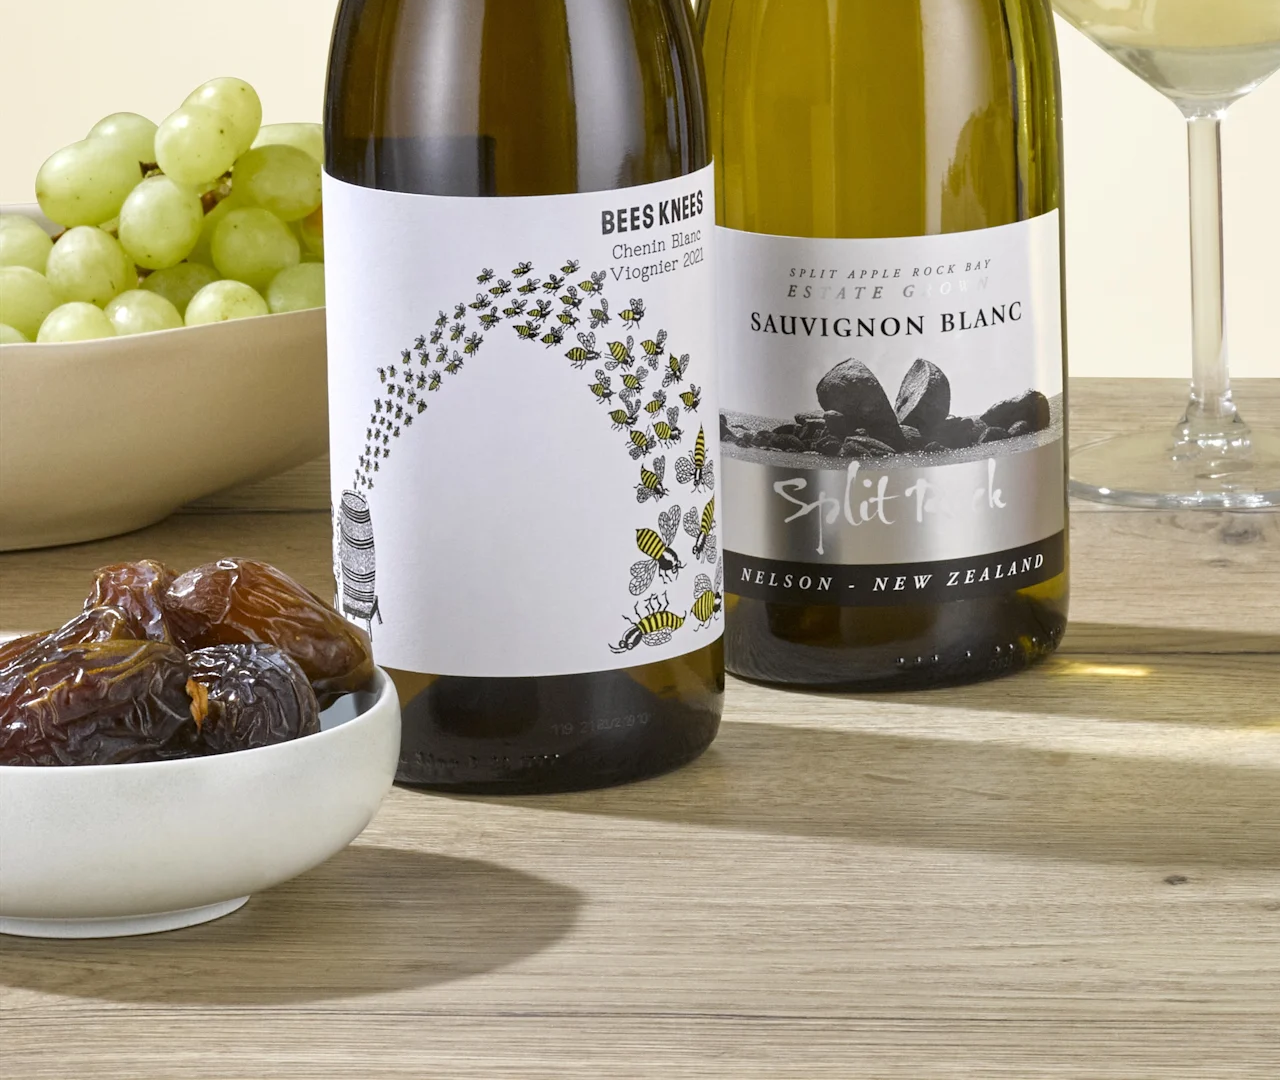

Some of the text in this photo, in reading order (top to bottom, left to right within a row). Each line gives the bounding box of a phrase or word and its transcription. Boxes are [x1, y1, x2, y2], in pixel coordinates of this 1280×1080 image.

[601, 190, 704, 235] BEES KNEES
[612, 228, 702, 261] Chenin Blanc
[610, 246, 704, 283] Viognier 2021
[789, 258, 992, 279] SPLIT APPLE ROCK BAY
[787, 284, 884, 300] ESTATE
[750, 301, 1023, 338] SAUVIGNON BLANC
[773, 460, 900, 556] Split
[740, 567, 834, 592] NELSON
[872, 574, 933, 592] NEW
[946, 553, 1045, 588] ZEALAND
